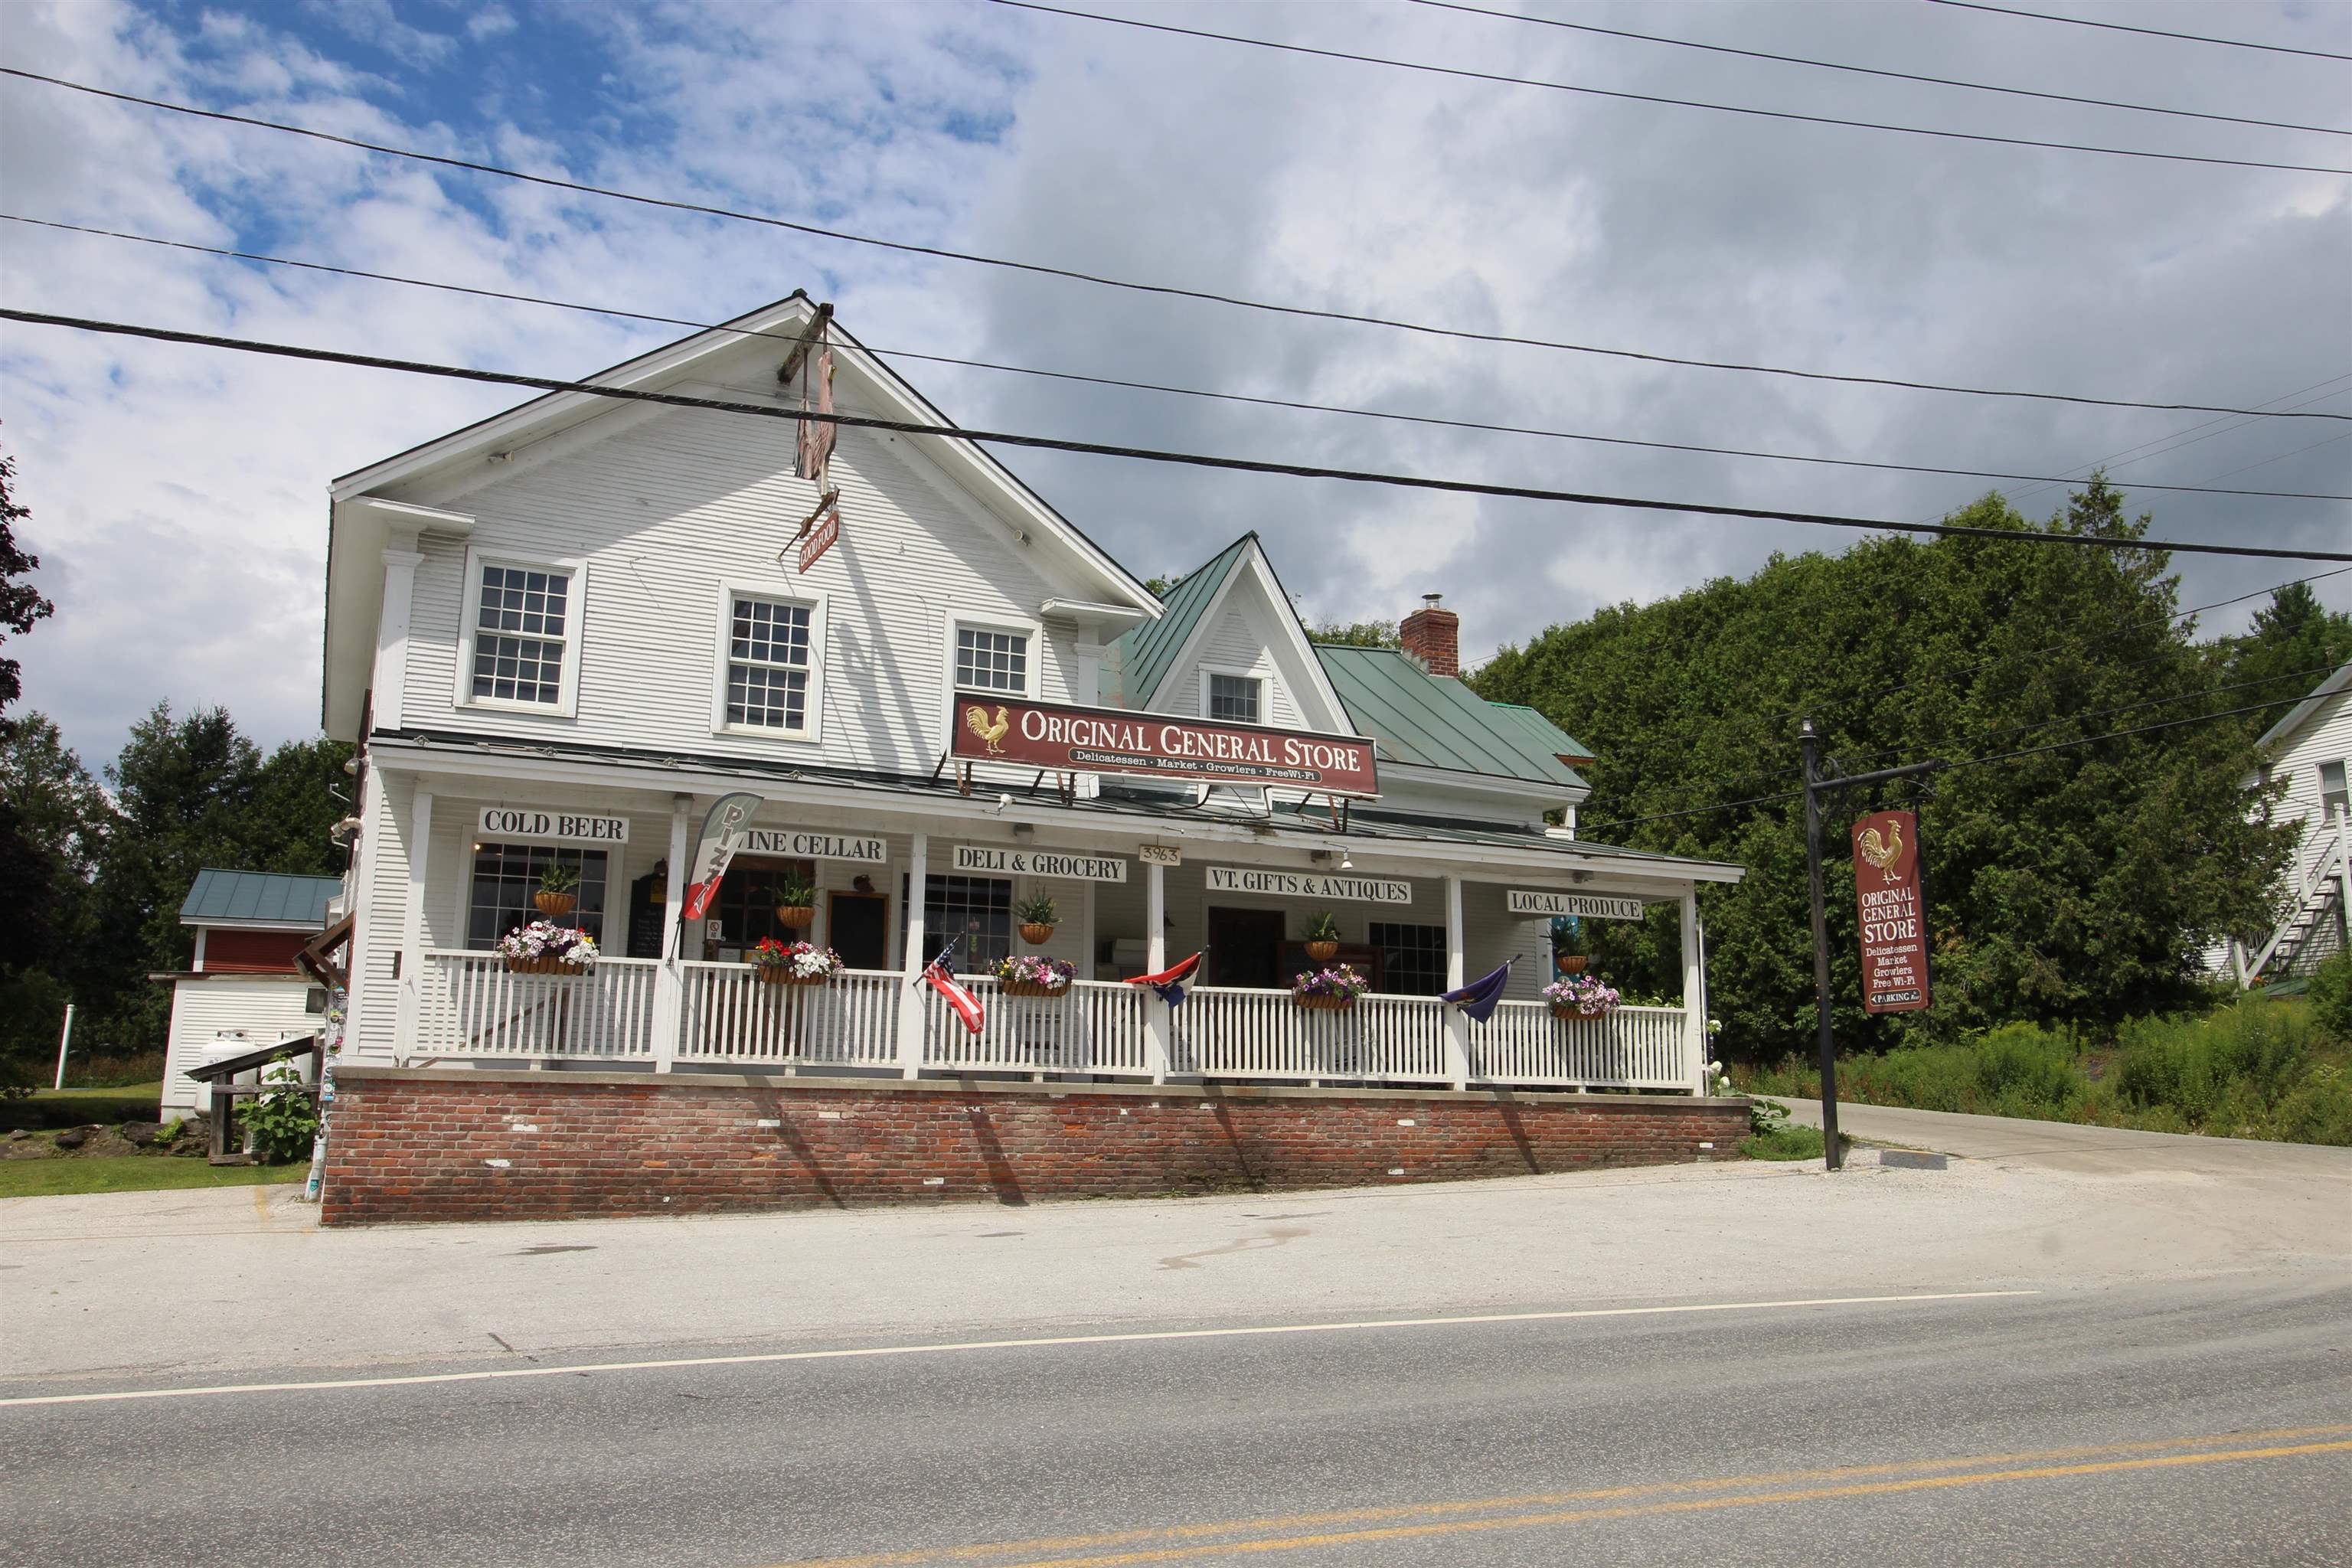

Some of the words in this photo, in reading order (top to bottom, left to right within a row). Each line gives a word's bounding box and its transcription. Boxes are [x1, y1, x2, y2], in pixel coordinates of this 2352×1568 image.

[801, 537, 818, 567] GOOD
[818, 520, 835, 550] FOOD
[1021, 710, 1151, 751] ORIGINAL
[1160, 725, 1277, 763] GENERAL
[1284, 738, 1361, 772] STORE
[1076, 750, 1147, 766] Delicatessen
[1157, 758, 1197, 770] Market
[1206, 763, 1256, 776] Growlers
[485, 810, 550, 835] COLD
[557, 815, 624, 840] BEER
[738, 830, 787, 853] INE
[793, 834, 882, 860] CELLAR
[1143, 847, 1178, 862] 3963
[959, 848, 1006, 870] DELI
[1011, 854, 1026, 871] &
[1032, 854, 1122, 879] GROCERY
[1212, 869, 1239, 888] VT.
[1243, 872, 1298, 893] GIFTS
[1303, 878, 1316, 894] &
[1320, 879, 1409, 901] ANTIQUES
[1861, 887, 1915, 907] ORIGINAL
[1512, 893, 1564, 912] LOCAL
[1568, 897, 1640, 917] PRODUCE
[1863, 902, 1916, 923] GENERAL
[1864, 919, 1917, 943] STORE
[1865, 944, 1918, 957] Delicatessen
[1877, 956, 1908, 966] Market
[1873, 966, 1913, 977] Growlers
[1873, 978, 1892, 988] Free
[1893, 975, 1916, 987] Wi-Fi
[1877, 992, 1909, 1004] PARKING
